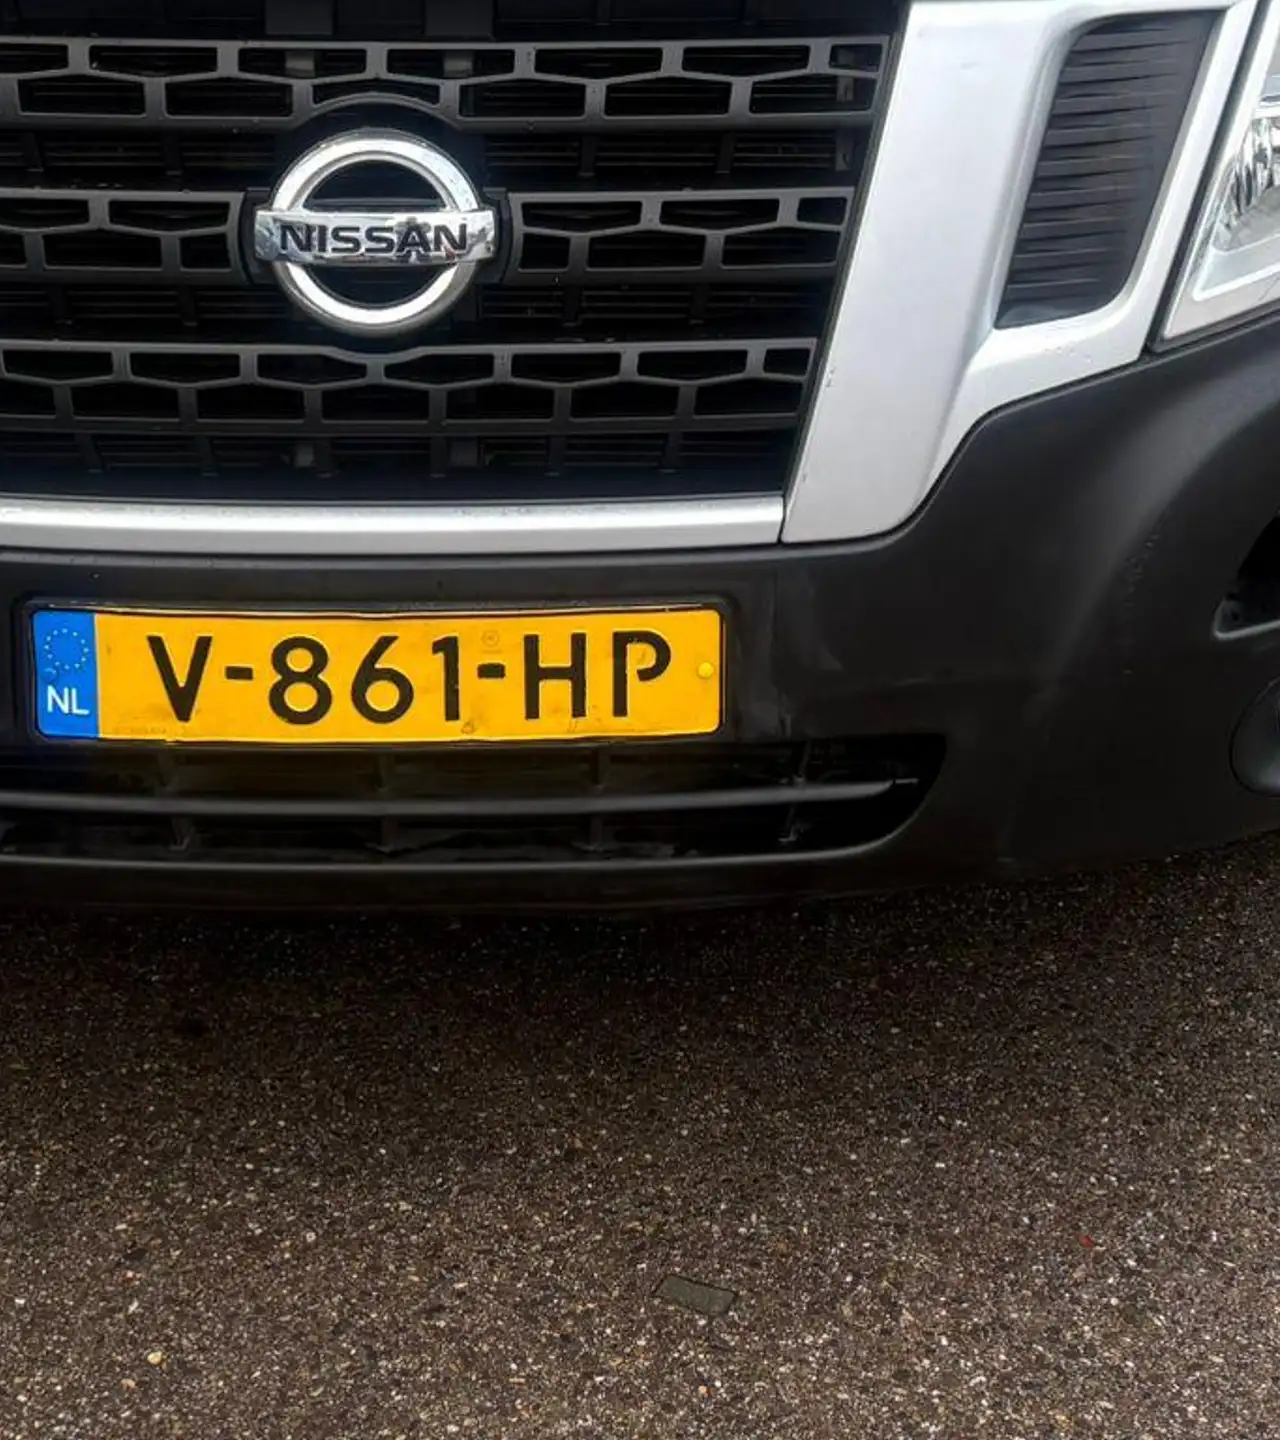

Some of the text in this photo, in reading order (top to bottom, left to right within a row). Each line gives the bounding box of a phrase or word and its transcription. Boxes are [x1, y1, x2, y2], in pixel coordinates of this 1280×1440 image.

[279, 222, 468, 254] NISSAN
[46, 629, 673, 726] NL V-861-HP
